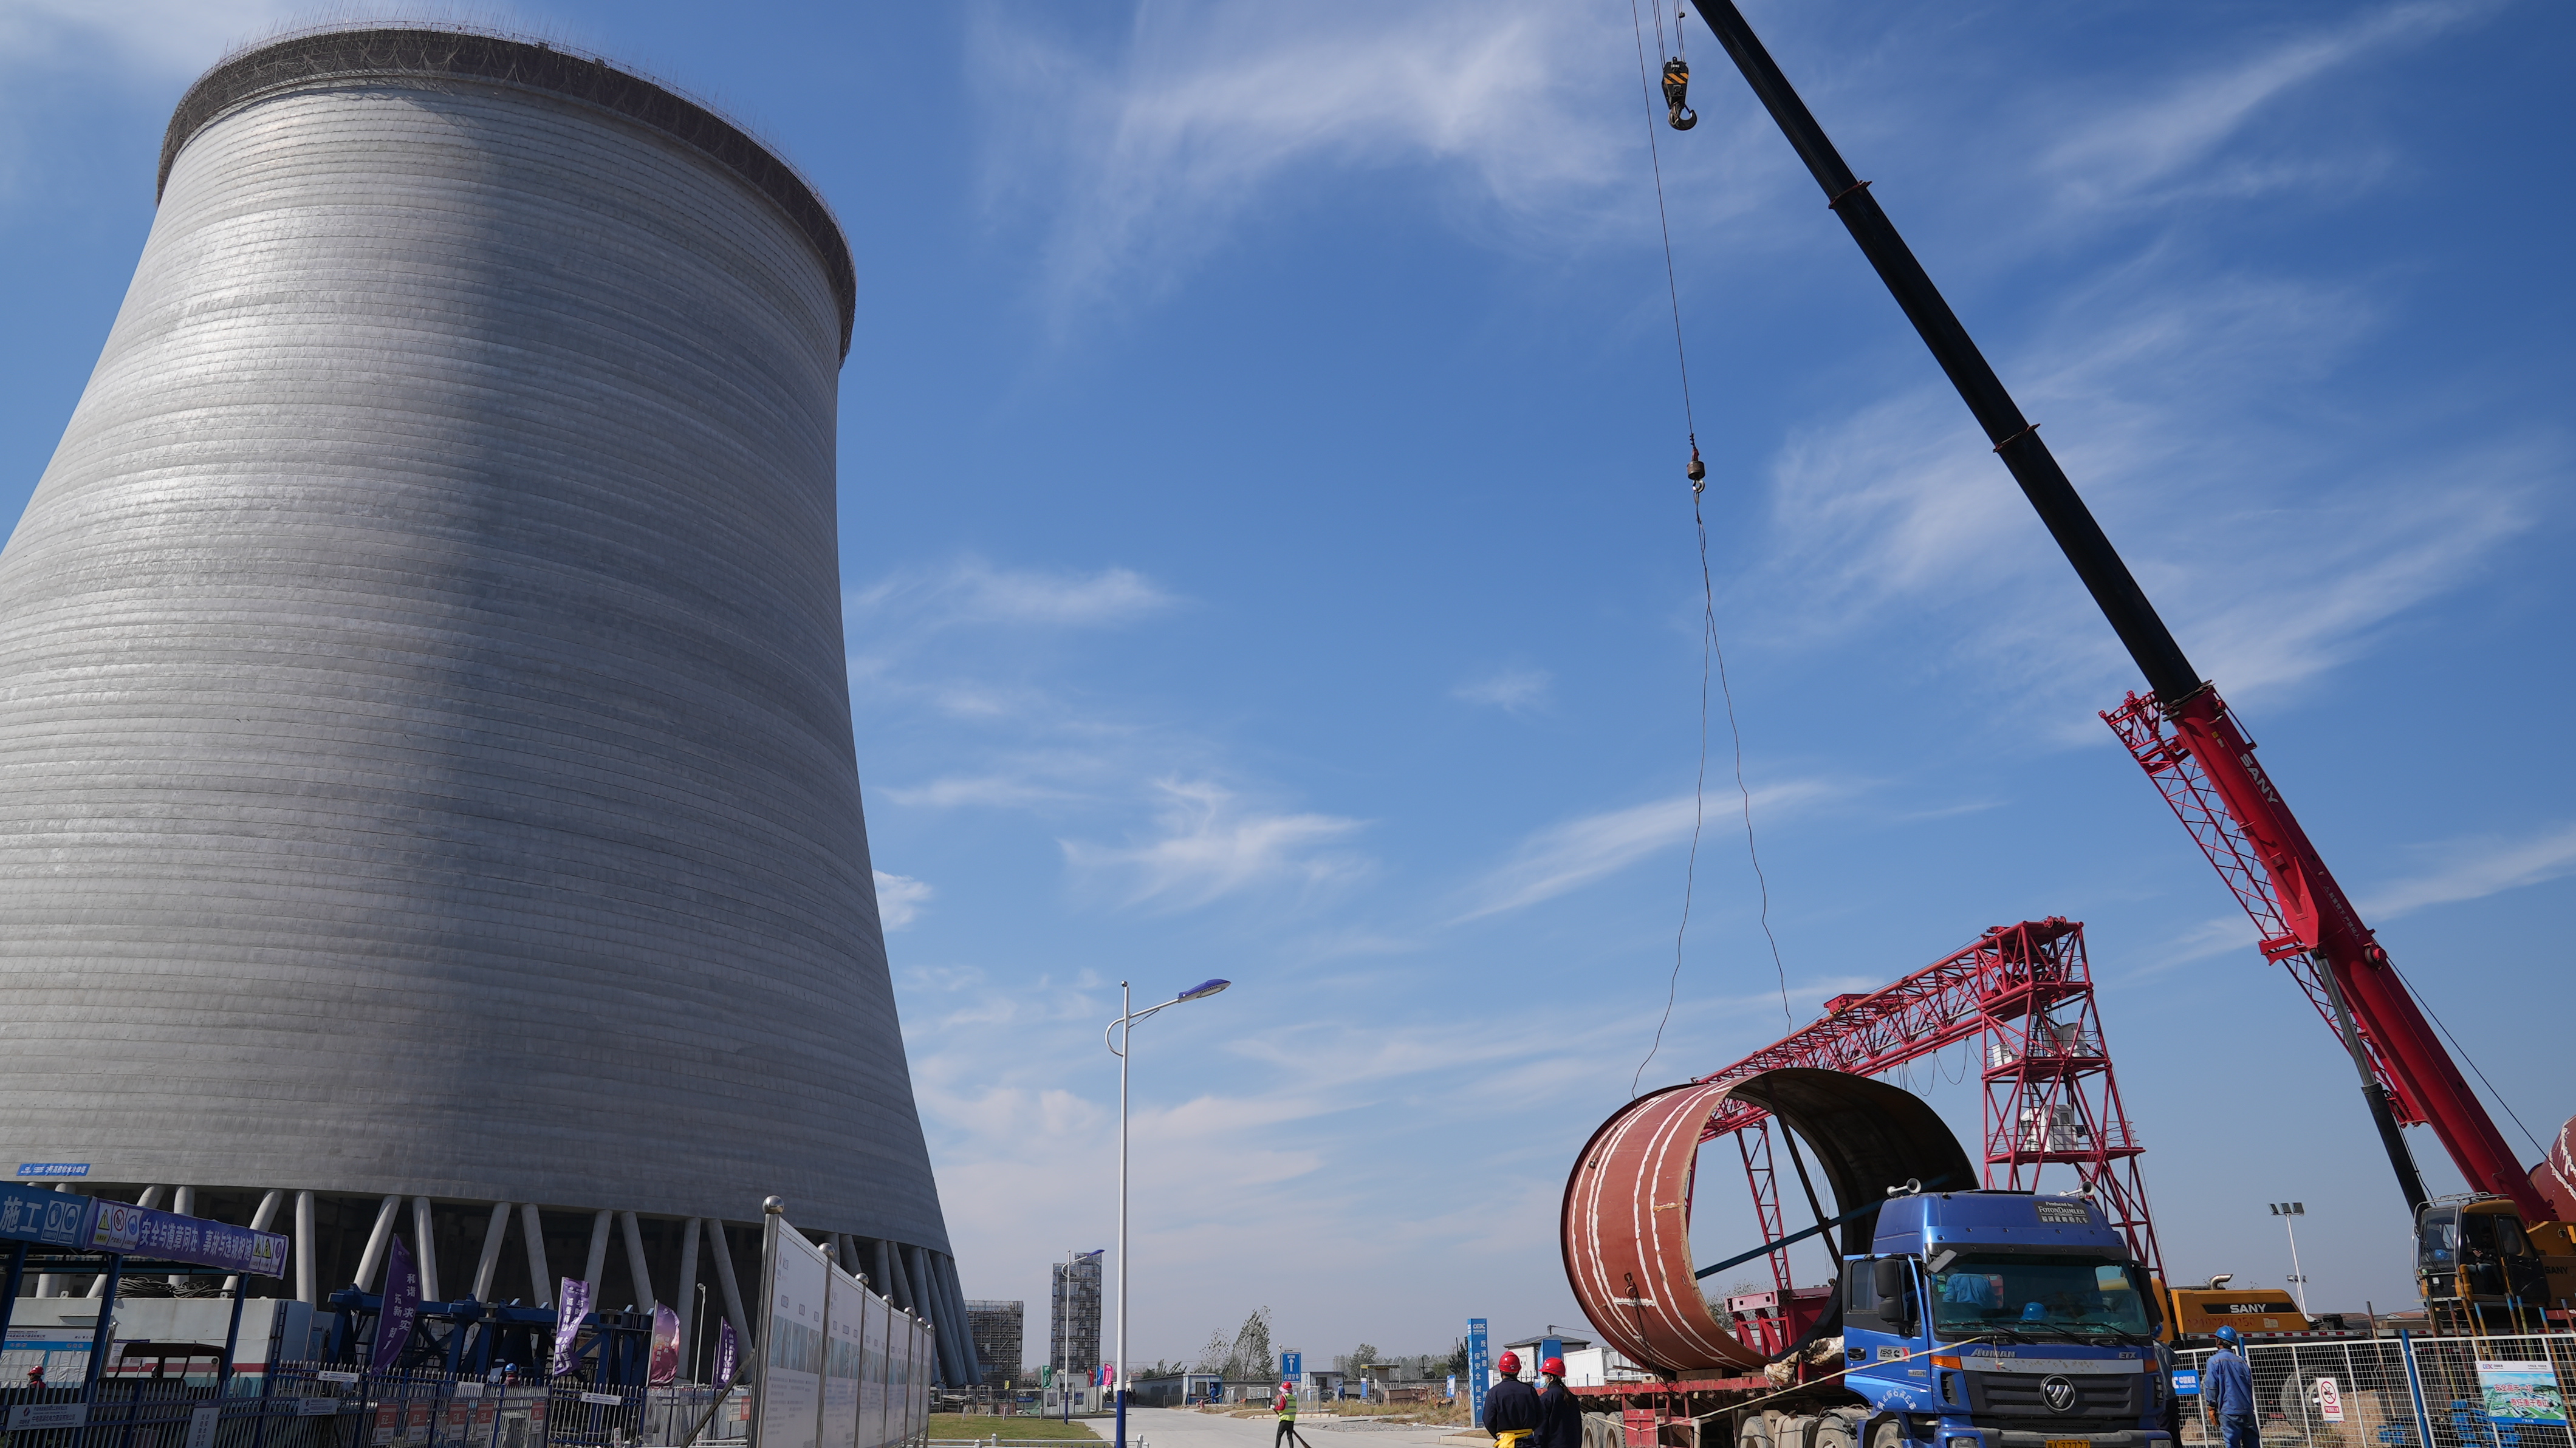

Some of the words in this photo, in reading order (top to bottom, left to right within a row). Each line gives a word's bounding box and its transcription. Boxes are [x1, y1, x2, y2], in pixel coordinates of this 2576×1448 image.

[2240, 753, 2278, 804] SANY
[1, 1195, 42, 1233] 施工
[140, 1218, 198, 1252] 安全与遵章同在
[203, 1229, 252, 1261] 事故与违规相随
[406, 1274, 416, 1297] 和谐
[399, 1308, 414, 1331] 求实
[2230, 1304, 2266, 1313] SANY
[2494, 1384, 2533, 1393] 安全高于一切
[2510, 1398, 2550, 1407] 责任重于泰山
